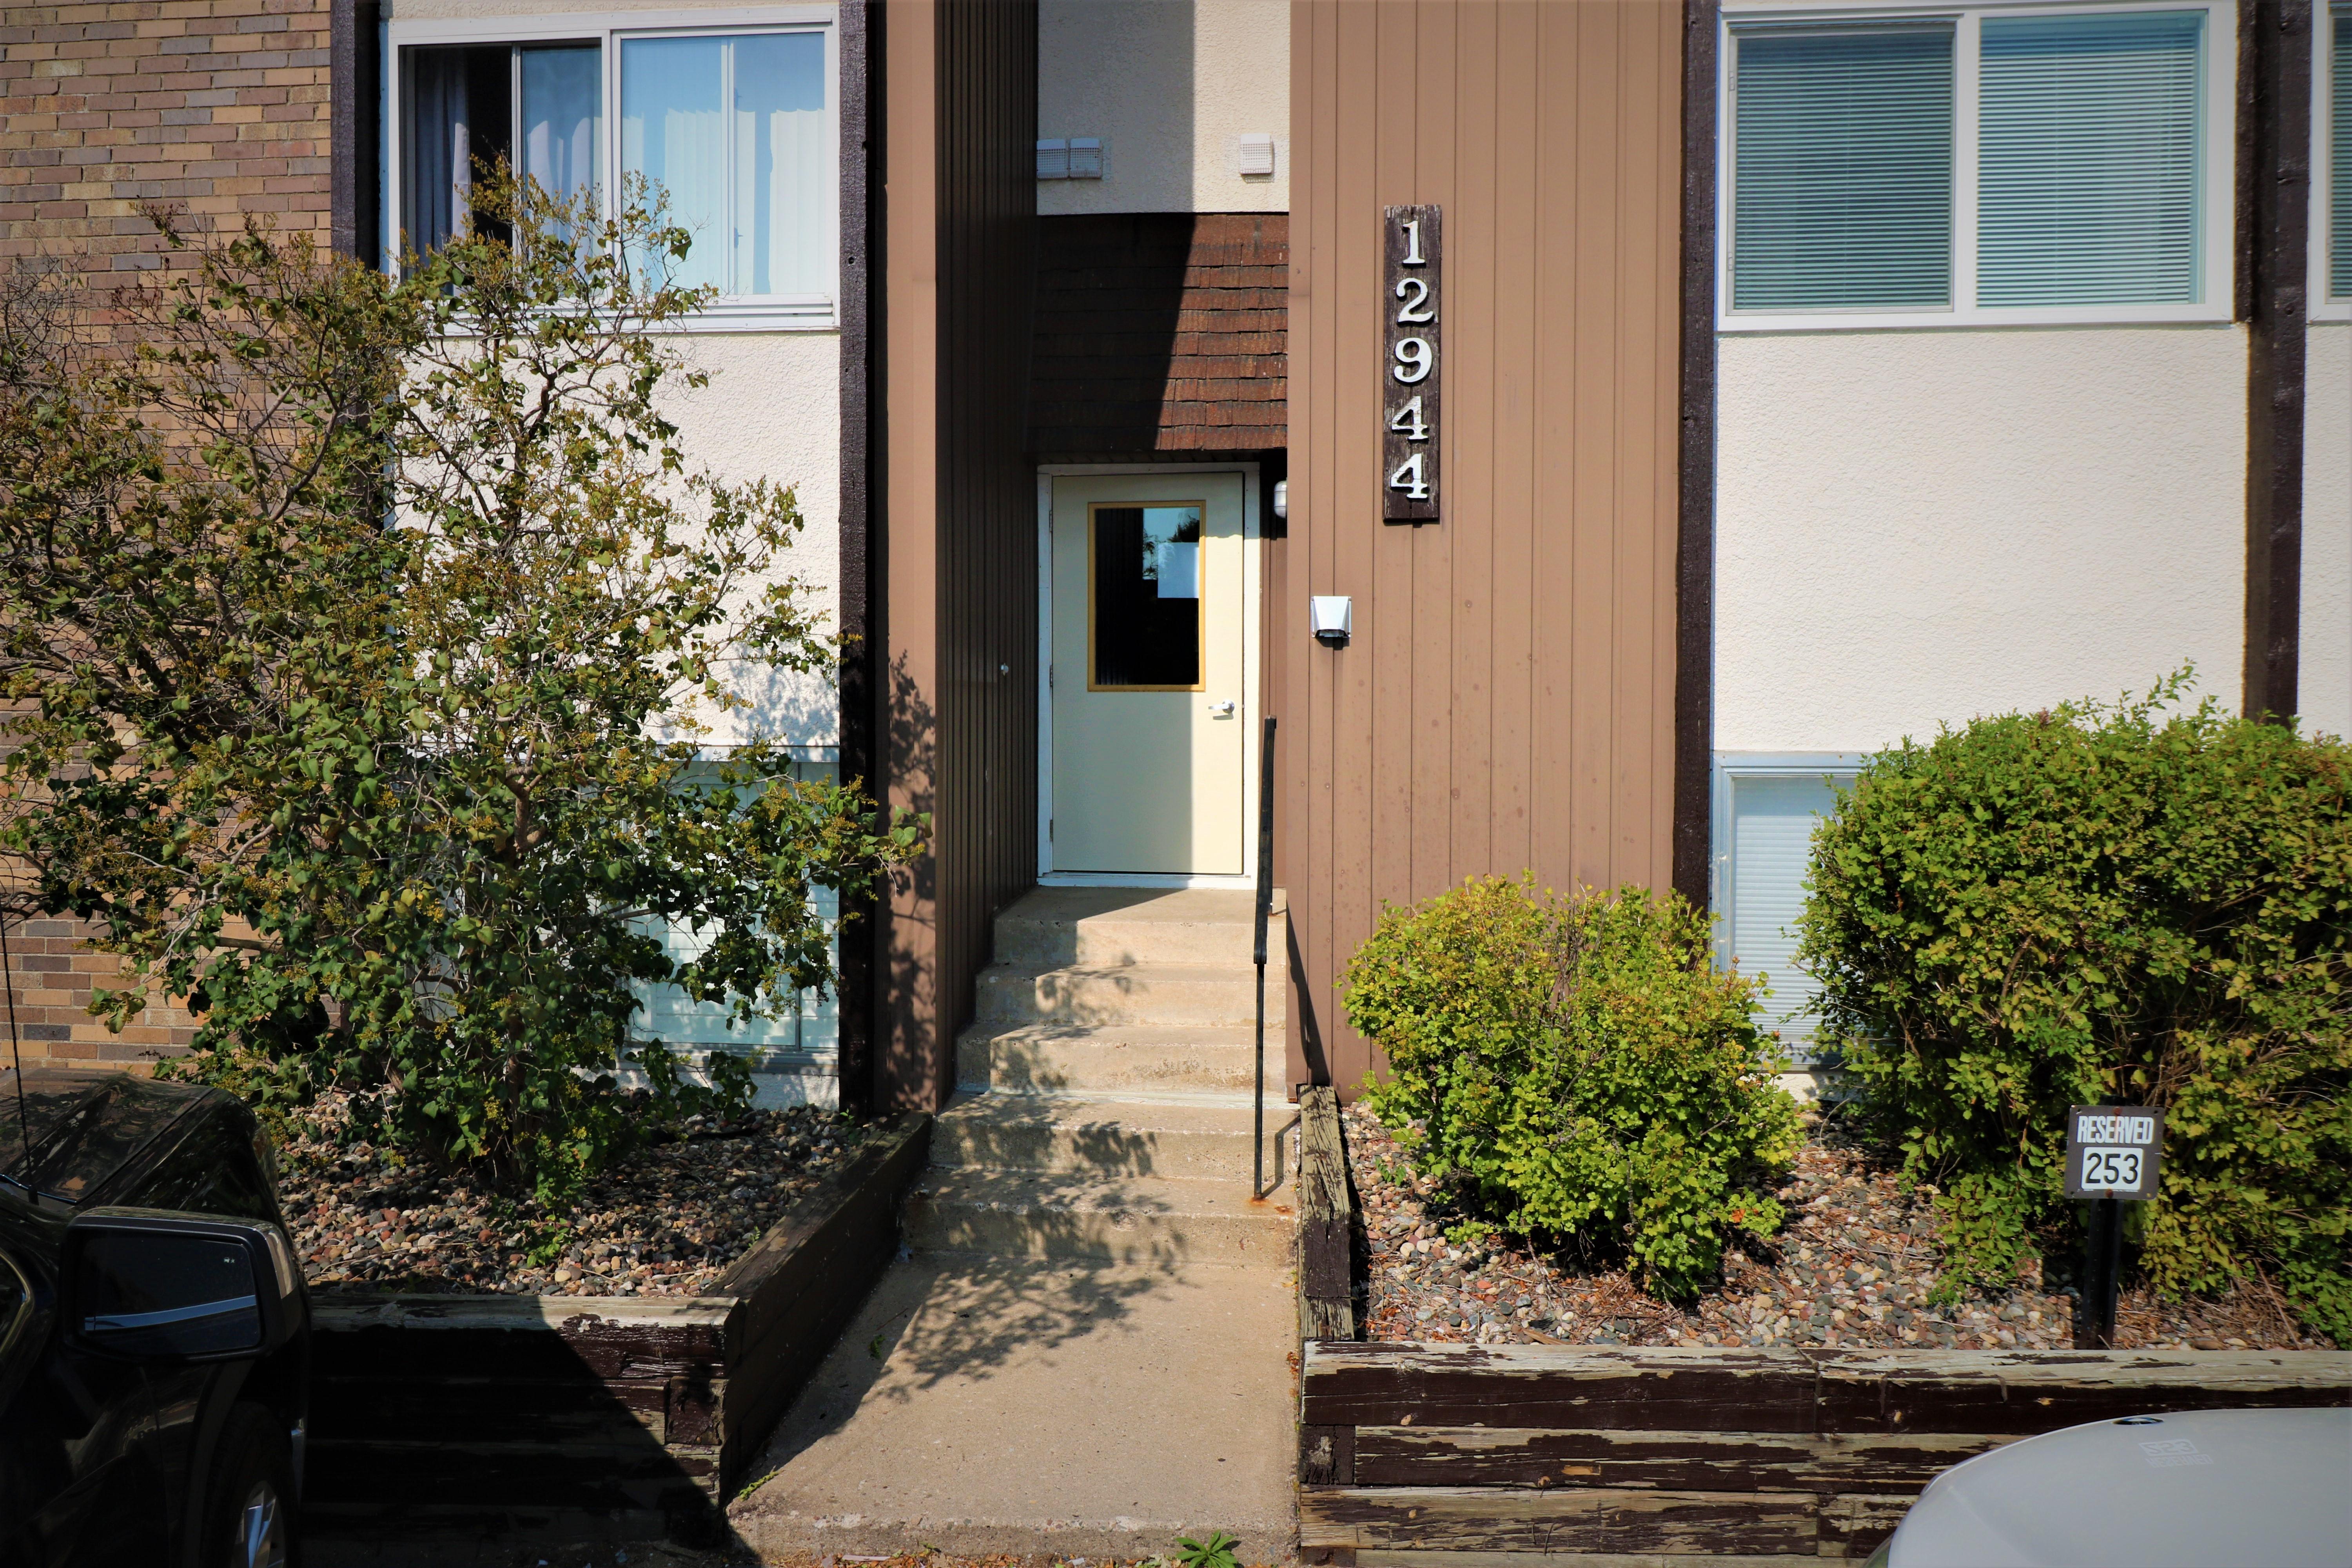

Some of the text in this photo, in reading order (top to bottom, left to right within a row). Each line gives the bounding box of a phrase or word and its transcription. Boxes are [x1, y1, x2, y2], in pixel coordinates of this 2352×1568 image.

[1390, 220, 1435, 499] 12944
[2077, 1115, 2154, 1144] RESERVED
[2085, 1152, 2139, 1184] 253
